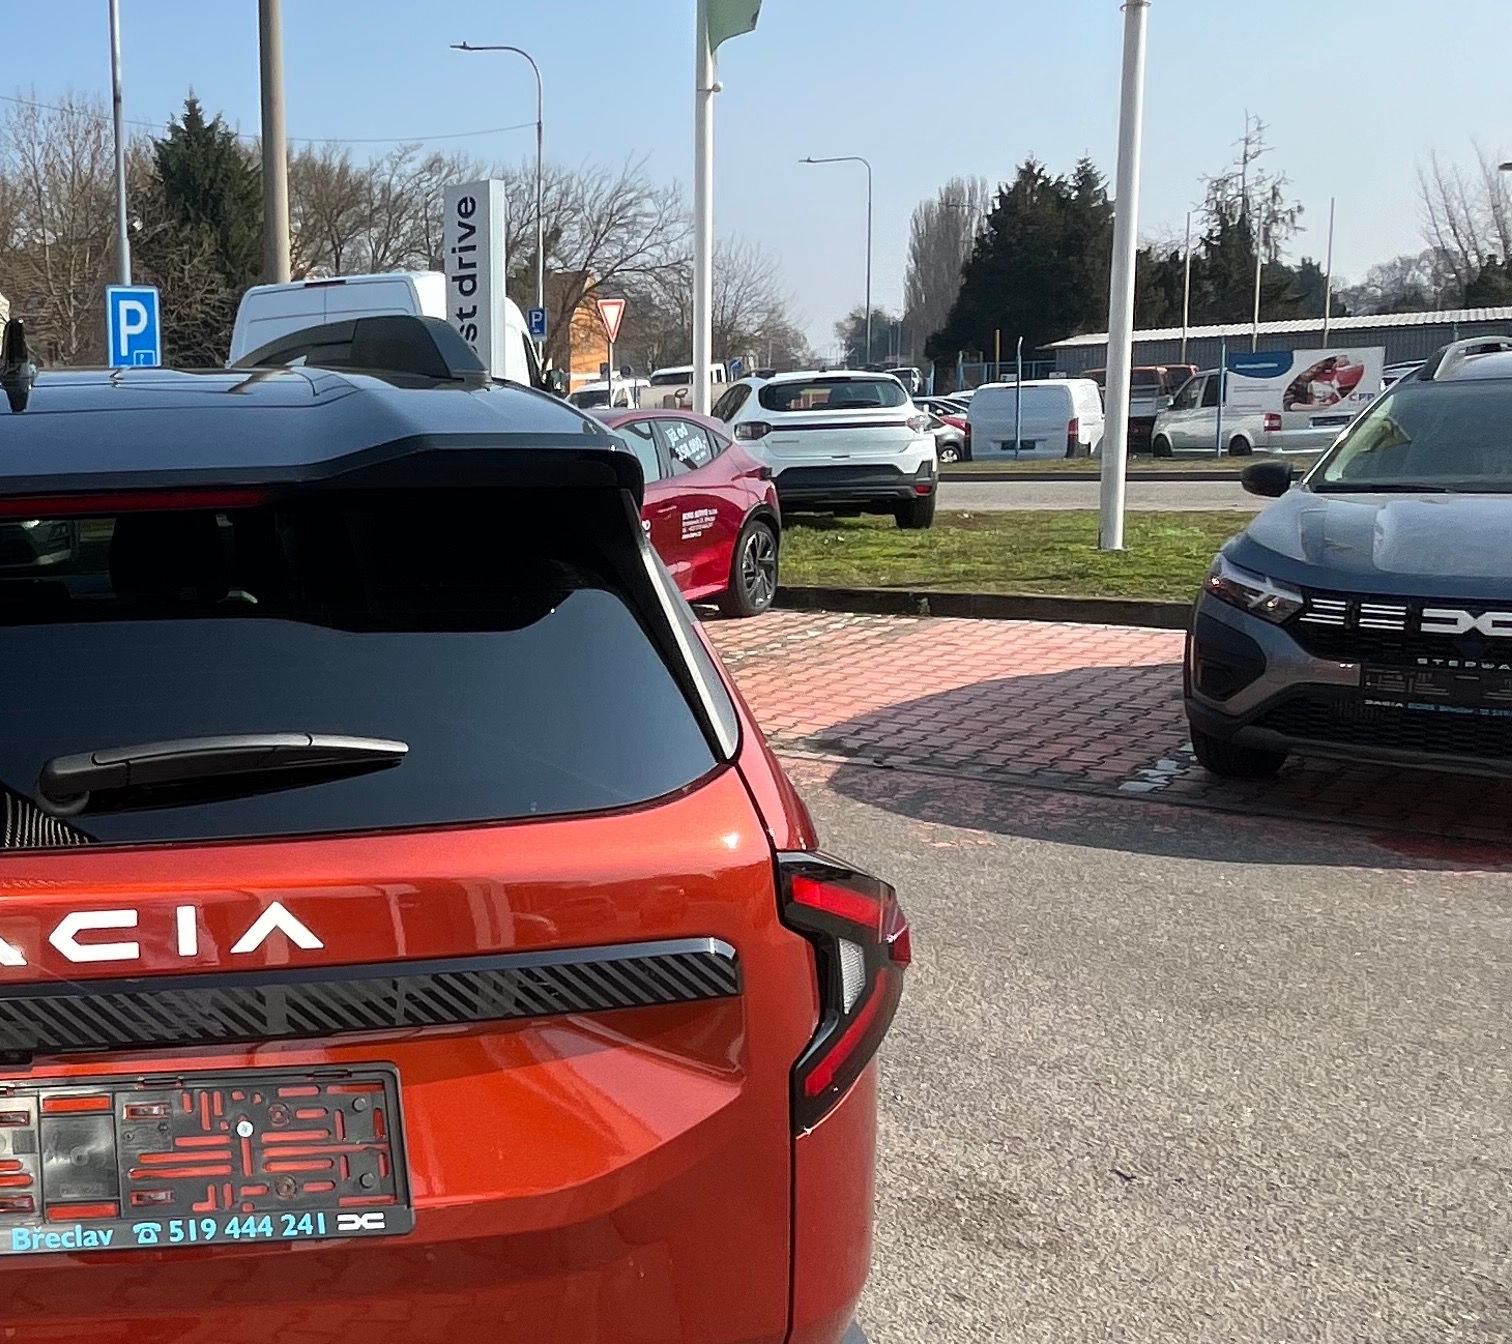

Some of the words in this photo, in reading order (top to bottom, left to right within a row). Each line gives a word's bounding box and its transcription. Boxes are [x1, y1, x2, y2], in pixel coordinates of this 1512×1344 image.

[451, 195, 477, 297] drive
[119, 300, 148, 356] P
[531, 311, 543, 328] P
[1417, 657, 1512, 671] STEPWA
[11, 1224, 114, 1252] Břeclav
[169, 1219, 217, 1243] 519
[224, 1214, 273, 1239] 444
[280, 1212, 326, 1237] 241
